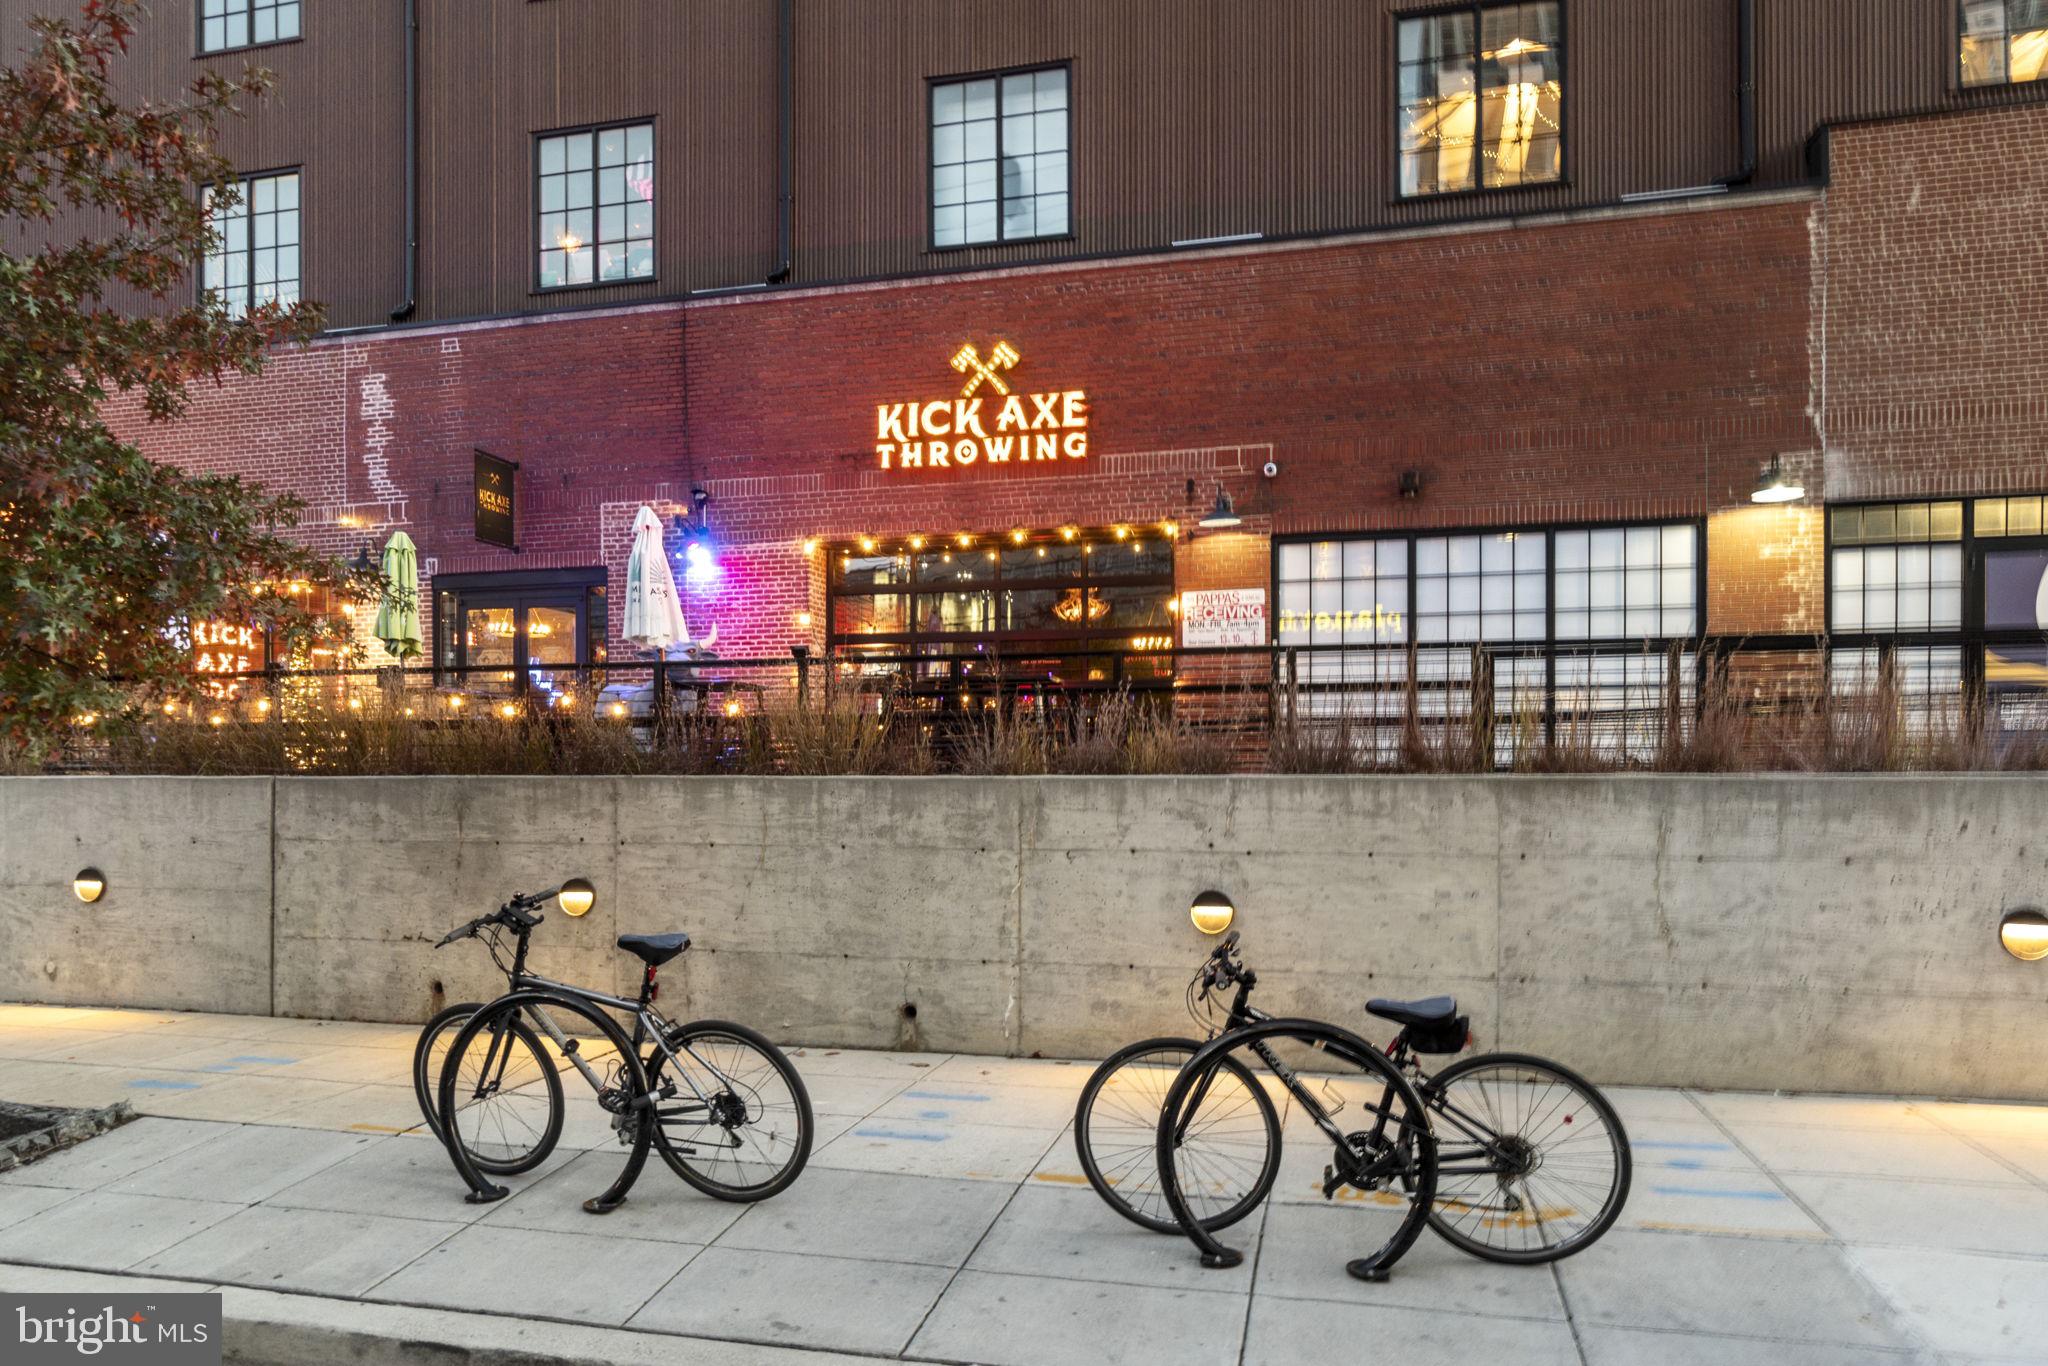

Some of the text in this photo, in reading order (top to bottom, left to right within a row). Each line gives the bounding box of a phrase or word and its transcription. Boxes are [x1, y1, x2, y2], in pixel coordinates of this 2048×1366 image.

[877, 391, 1088, 442] KICK AXE
[876, 432, 1087, 469] THROWING
[1196, 591, 1240, 606] PAPPAS
[1184, 604, 1263, 620] RECEIVING
[193, 621, 255, 650] KICK
[197, 652, 251, 673] AXE
